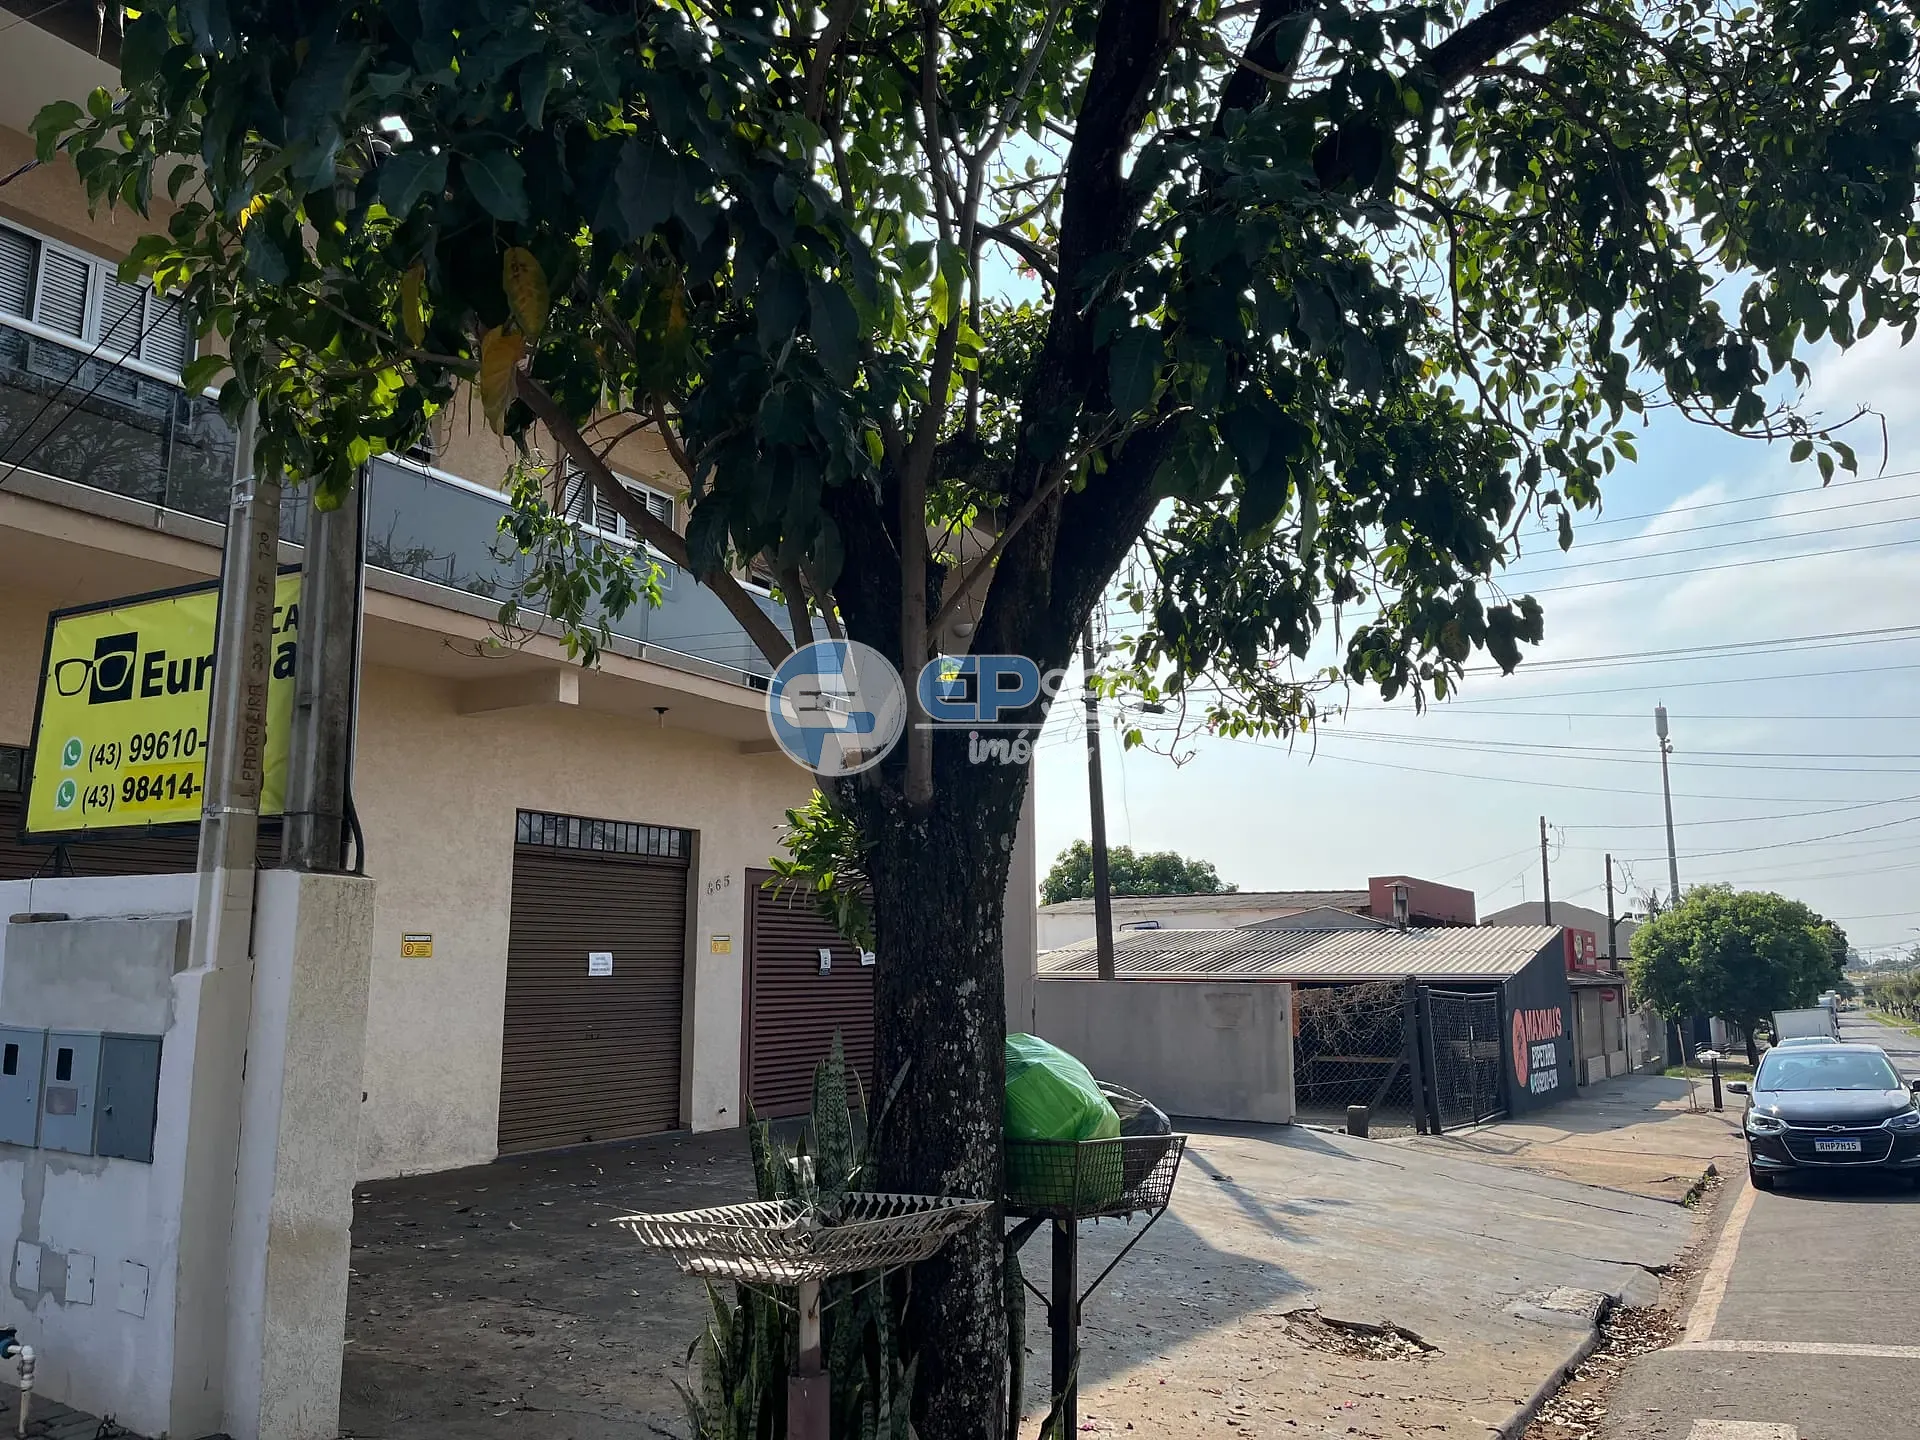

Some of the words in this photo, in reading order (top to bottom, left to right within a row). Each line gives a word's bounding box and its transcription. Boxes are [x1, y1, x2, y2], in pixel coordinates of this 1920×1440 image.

[89, 742, 121, 772] (43)
[129, 728, 208, 762] 99610-
[82, 784, 115, 814] (43)
[122, 772, 201, 802] 98414-
